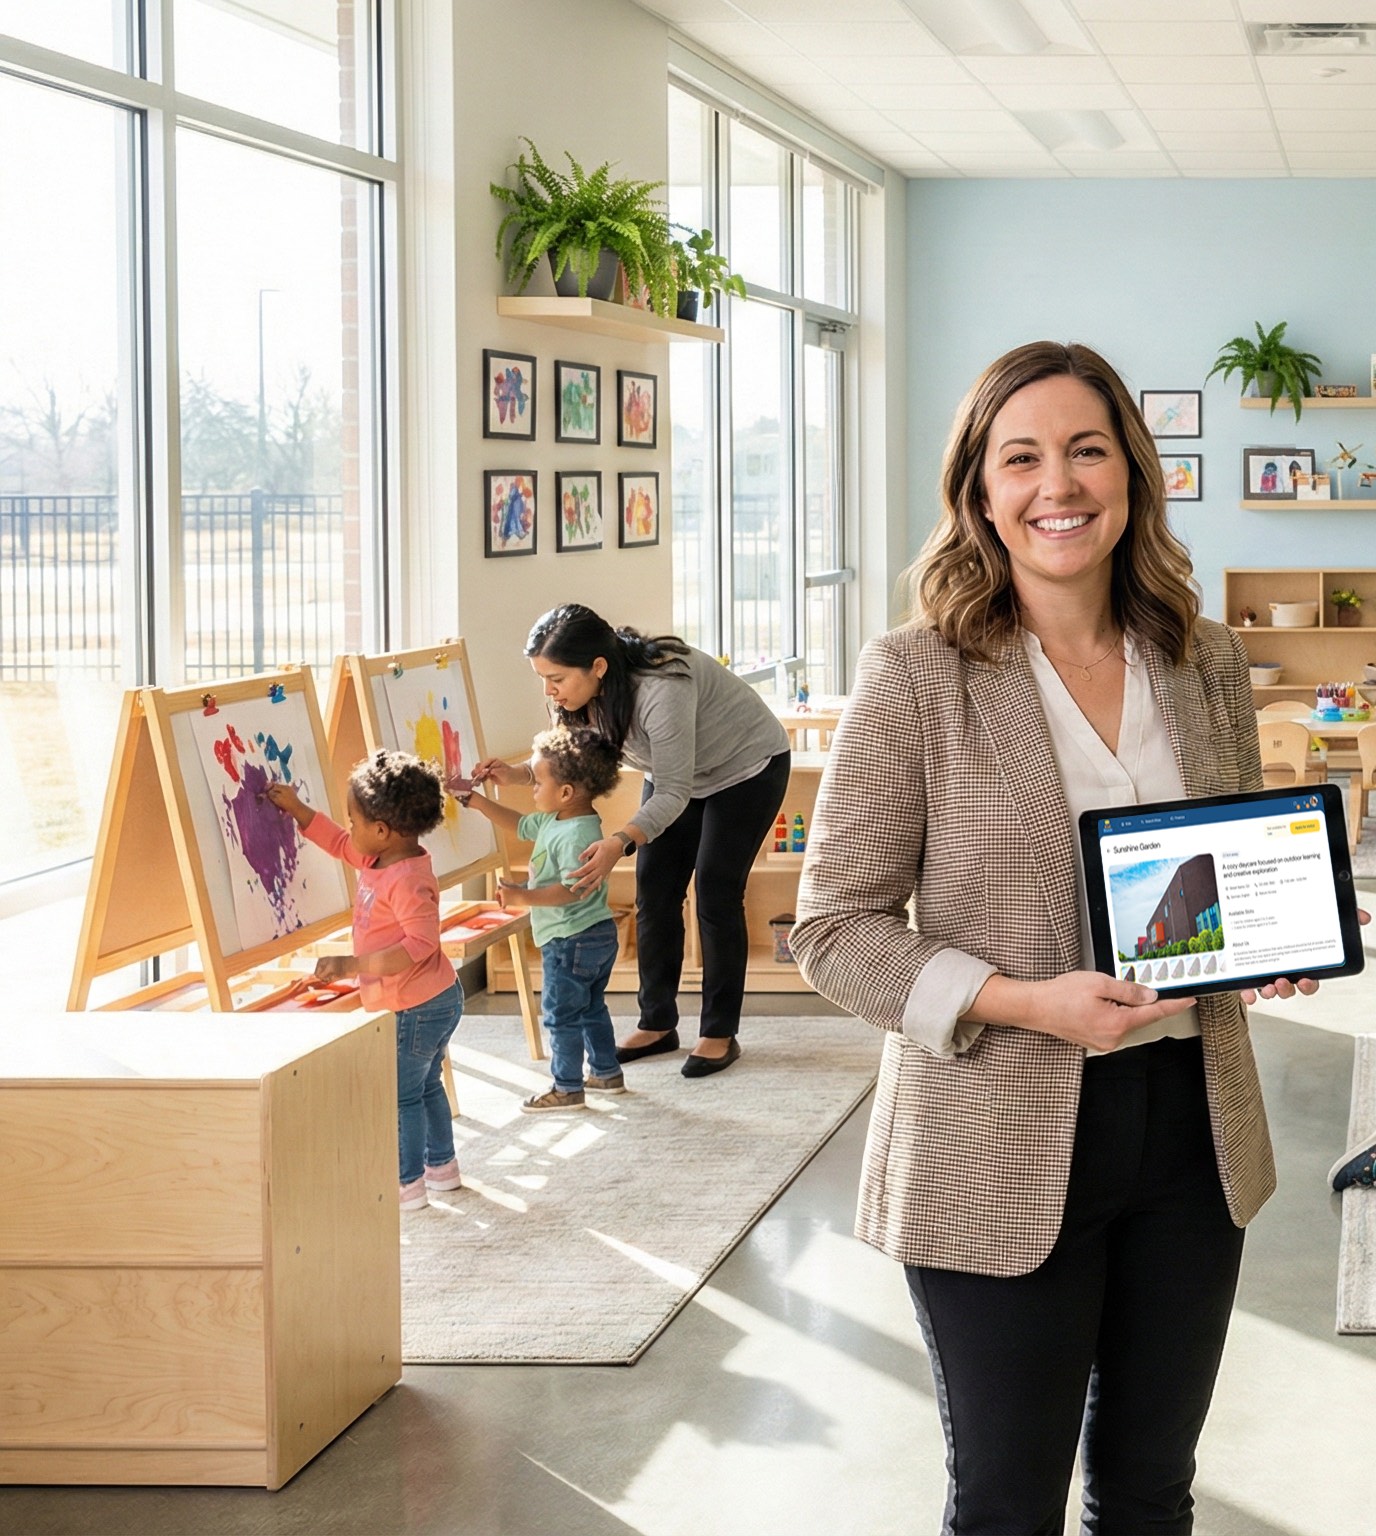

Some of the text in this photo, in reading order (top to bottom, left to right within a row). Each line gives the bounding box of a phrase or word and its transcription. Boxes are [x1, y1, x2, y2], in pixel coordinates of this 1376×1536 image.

[1113, 842, 1161, 854] Sunshine Garden
[1227, 863, 1238, 871] cozy
[1239, 860, 1257, 869] daycare
[1257, 858, 1277, 867] focused
[1302, 852, 1321, 861] learning
[1233, 869, 1251, 877] creative
[1252, 866, 1278, 876] exploration
